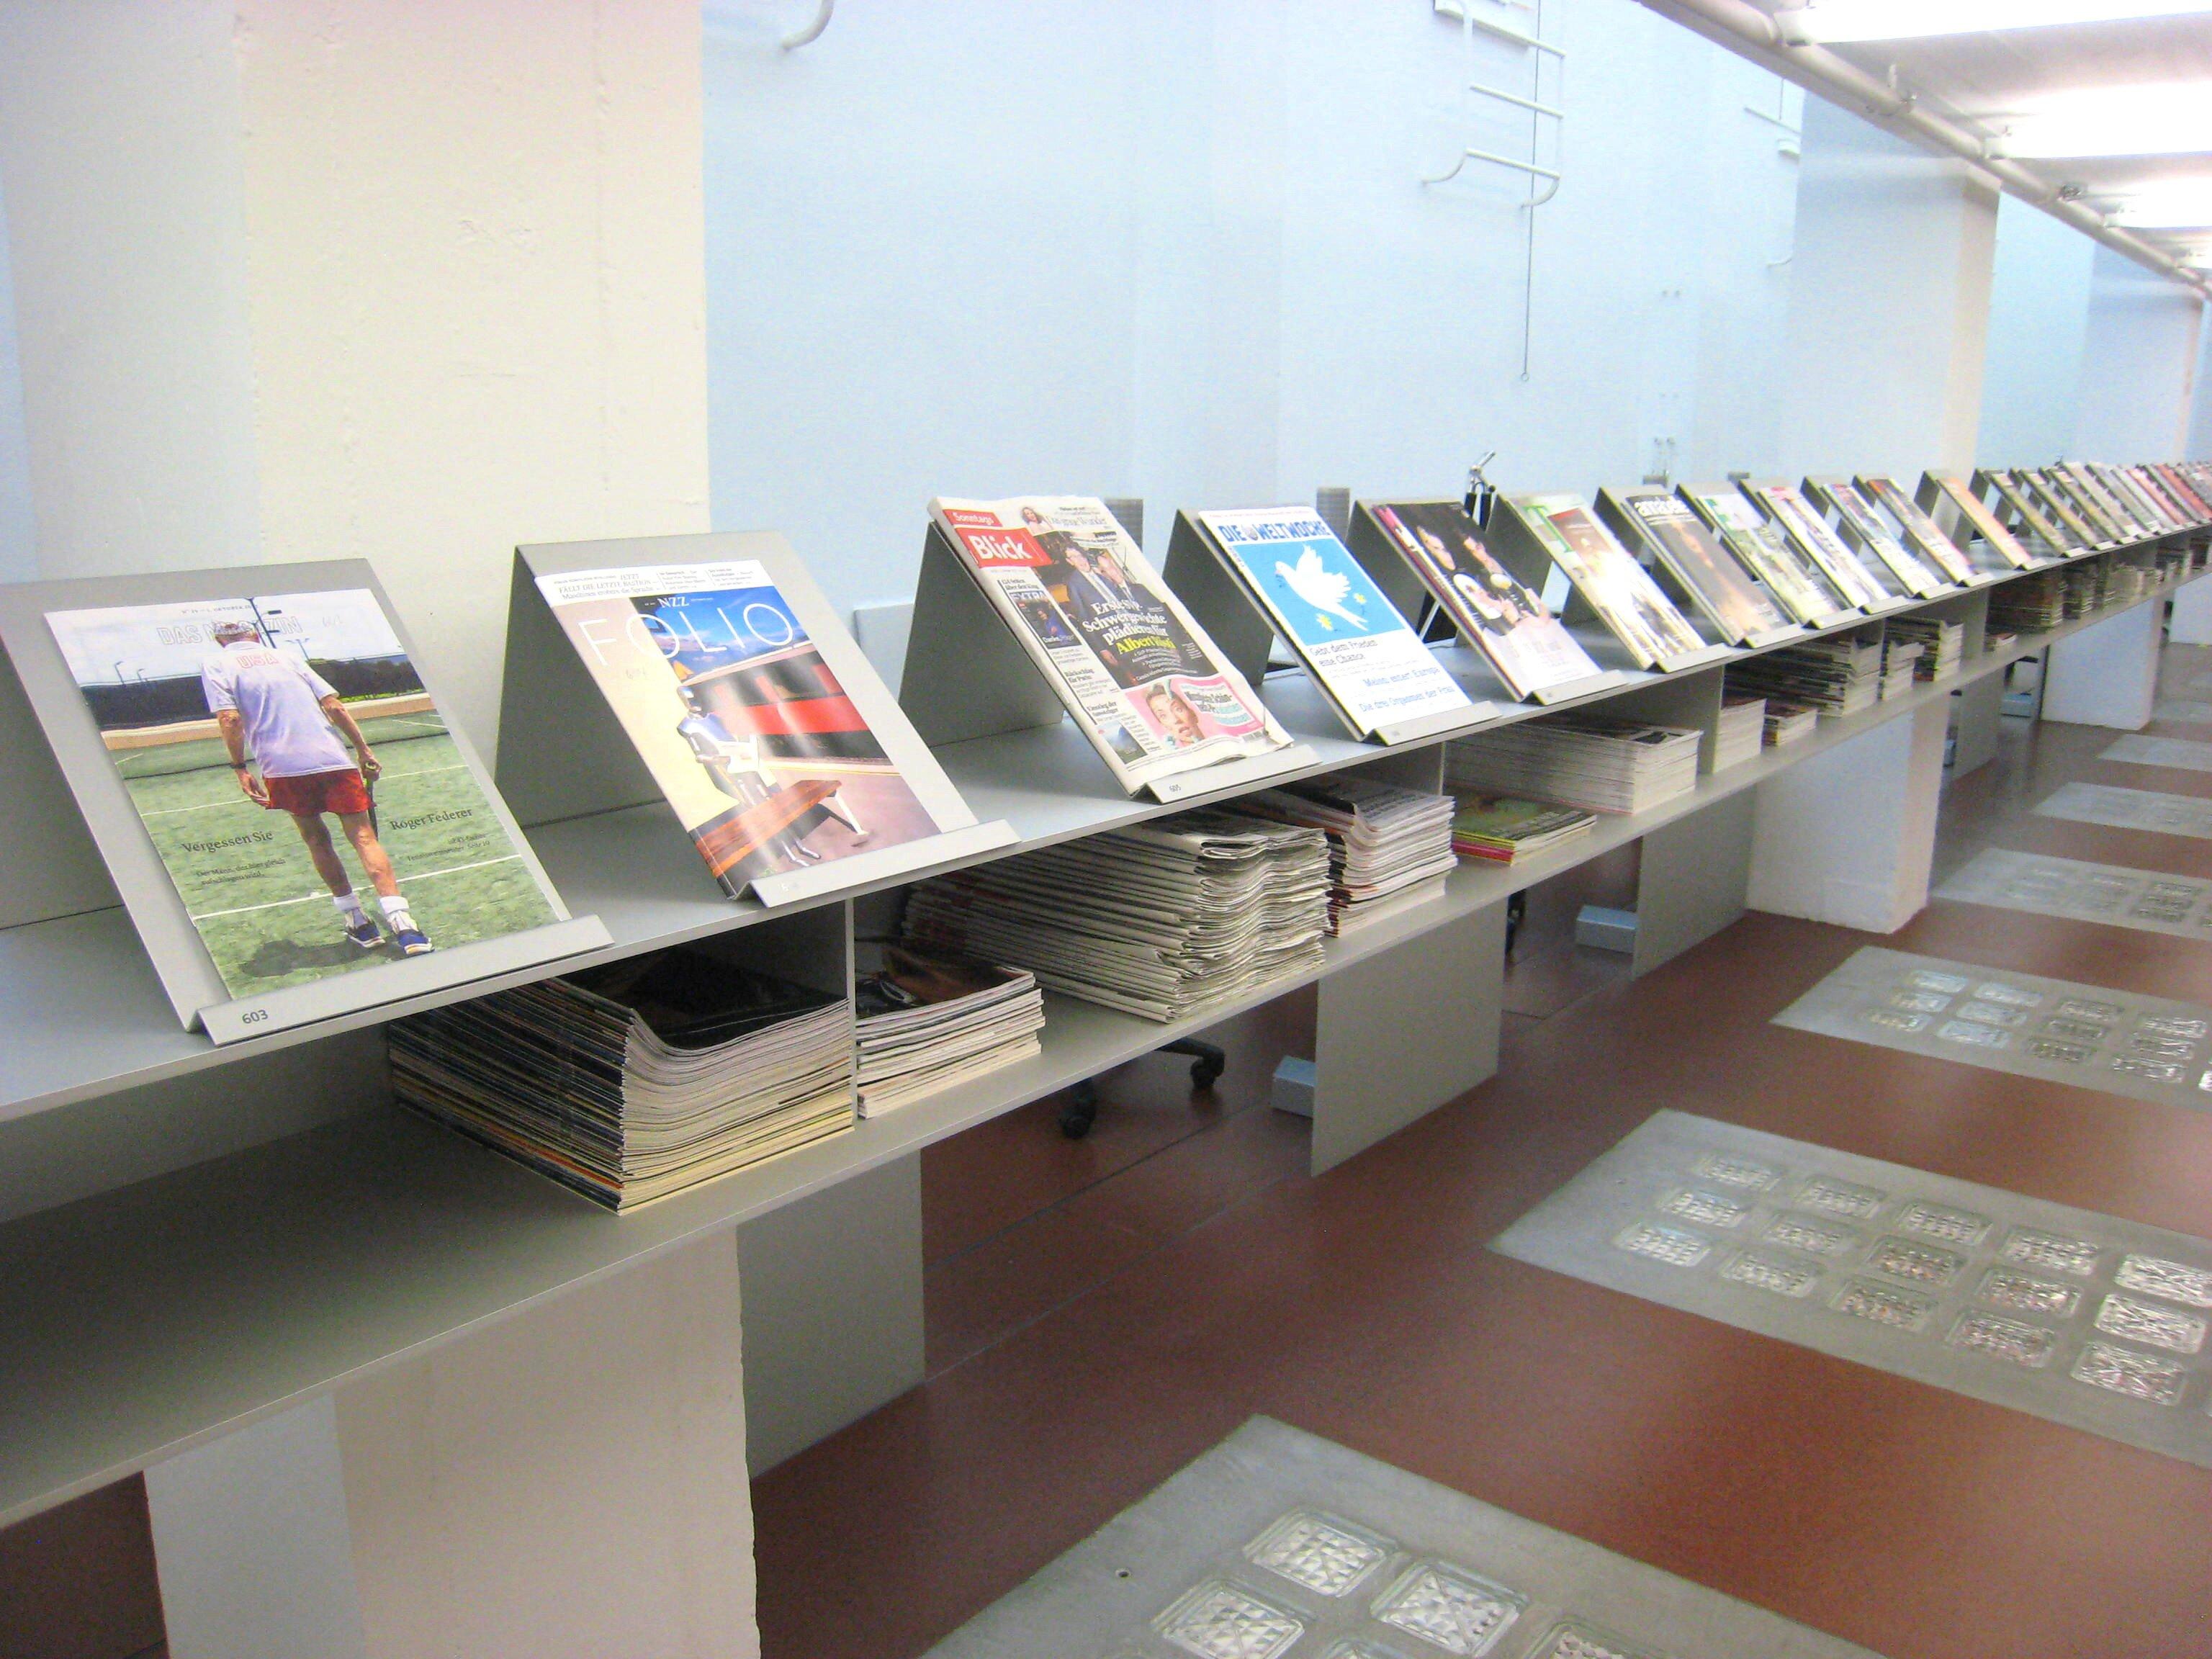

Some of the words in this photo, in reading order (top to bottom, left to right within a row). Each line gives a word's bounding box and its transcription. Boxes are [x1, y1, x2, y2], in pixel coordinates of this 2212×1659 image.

[953, 512, 994, 525] Sonntags
[1218, 525, 1248, 541] DIE
[1252, 521, 1331, 539] WELTWOCHE
[968, 535, 1033, 559] Blick
[657, 596, 690, 608] NZZ
[156, 627, 202, 645] DAS
[577, 603, 793, 667] FOLIO
[237, 653, 279, 669] USA
[390, 815, 426, 830] Roger
[427, 809, 474, 824] Federer
[181, 834, 253, 853] Vergessen
[253, 830, 274, 842] Sie
[242, 1010, 269, 1024] 603
